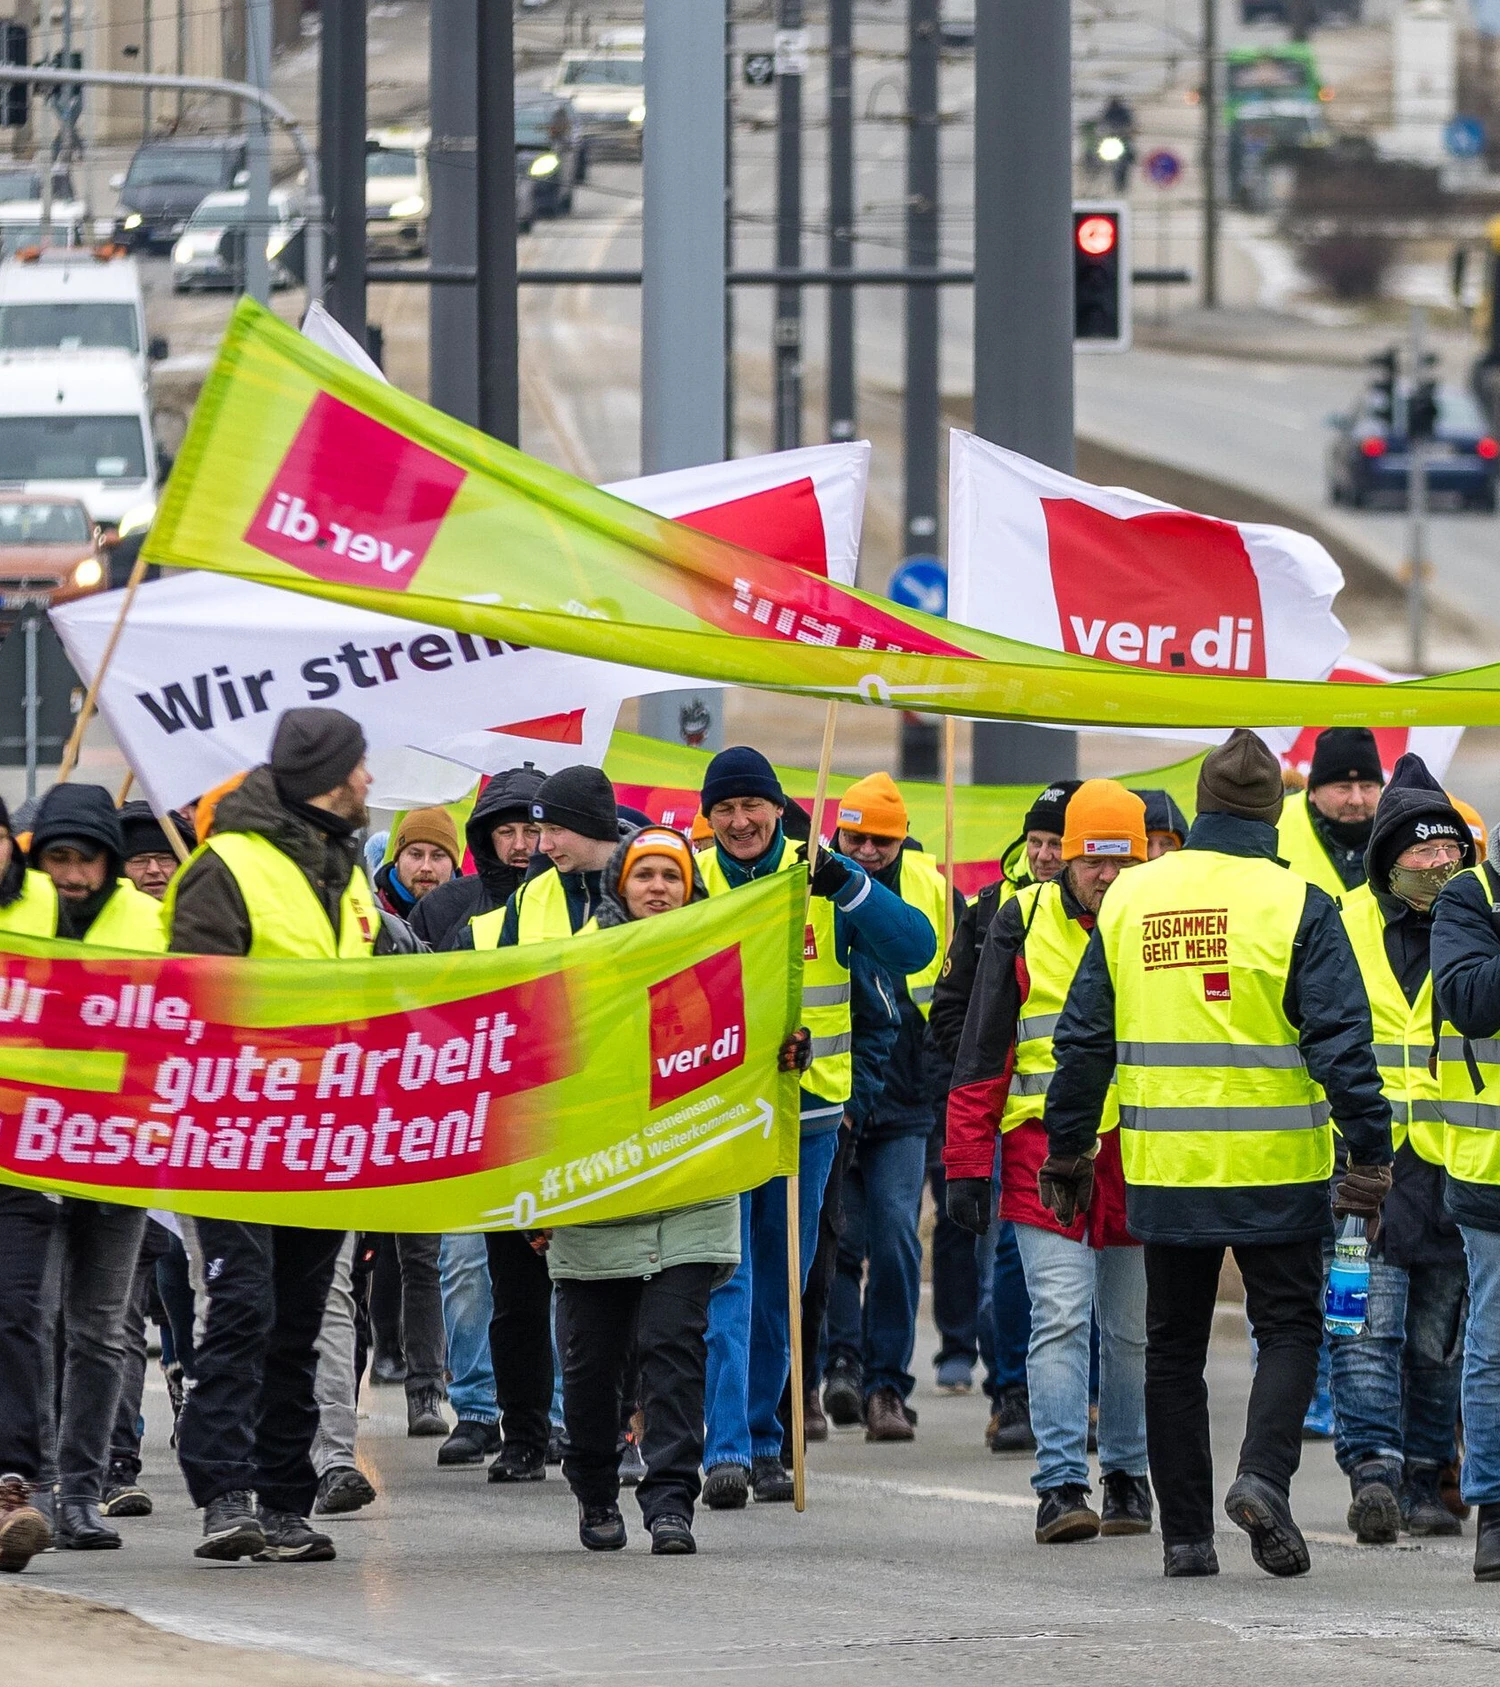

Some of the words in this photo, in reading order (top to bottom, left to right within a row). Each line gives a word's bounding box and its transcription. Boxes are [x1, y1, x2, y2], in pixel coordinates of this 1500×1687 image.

[1069, 615, 1252, 670] ver.di
[135, 665, 273, 735] Wir
[300, 630, 531, 700] strei
[1142, 915, 1227, 941] ZUSAMMEN
[1142, 940, 1179, 963] GEHT
[1185, 938, 1228, 959] MEHR
[150, 1046, 302, 1113] gute
[315, 1012, 517, 1099] Arbeit
[656, 1025, 740, 1078] ver.di
[14, 1091, 491, 1182] Beschäftigten!
[643, 1094, 725, 1137] Gemeinsam.
[647, 1103, 751, 1159] Weiterkommen.
